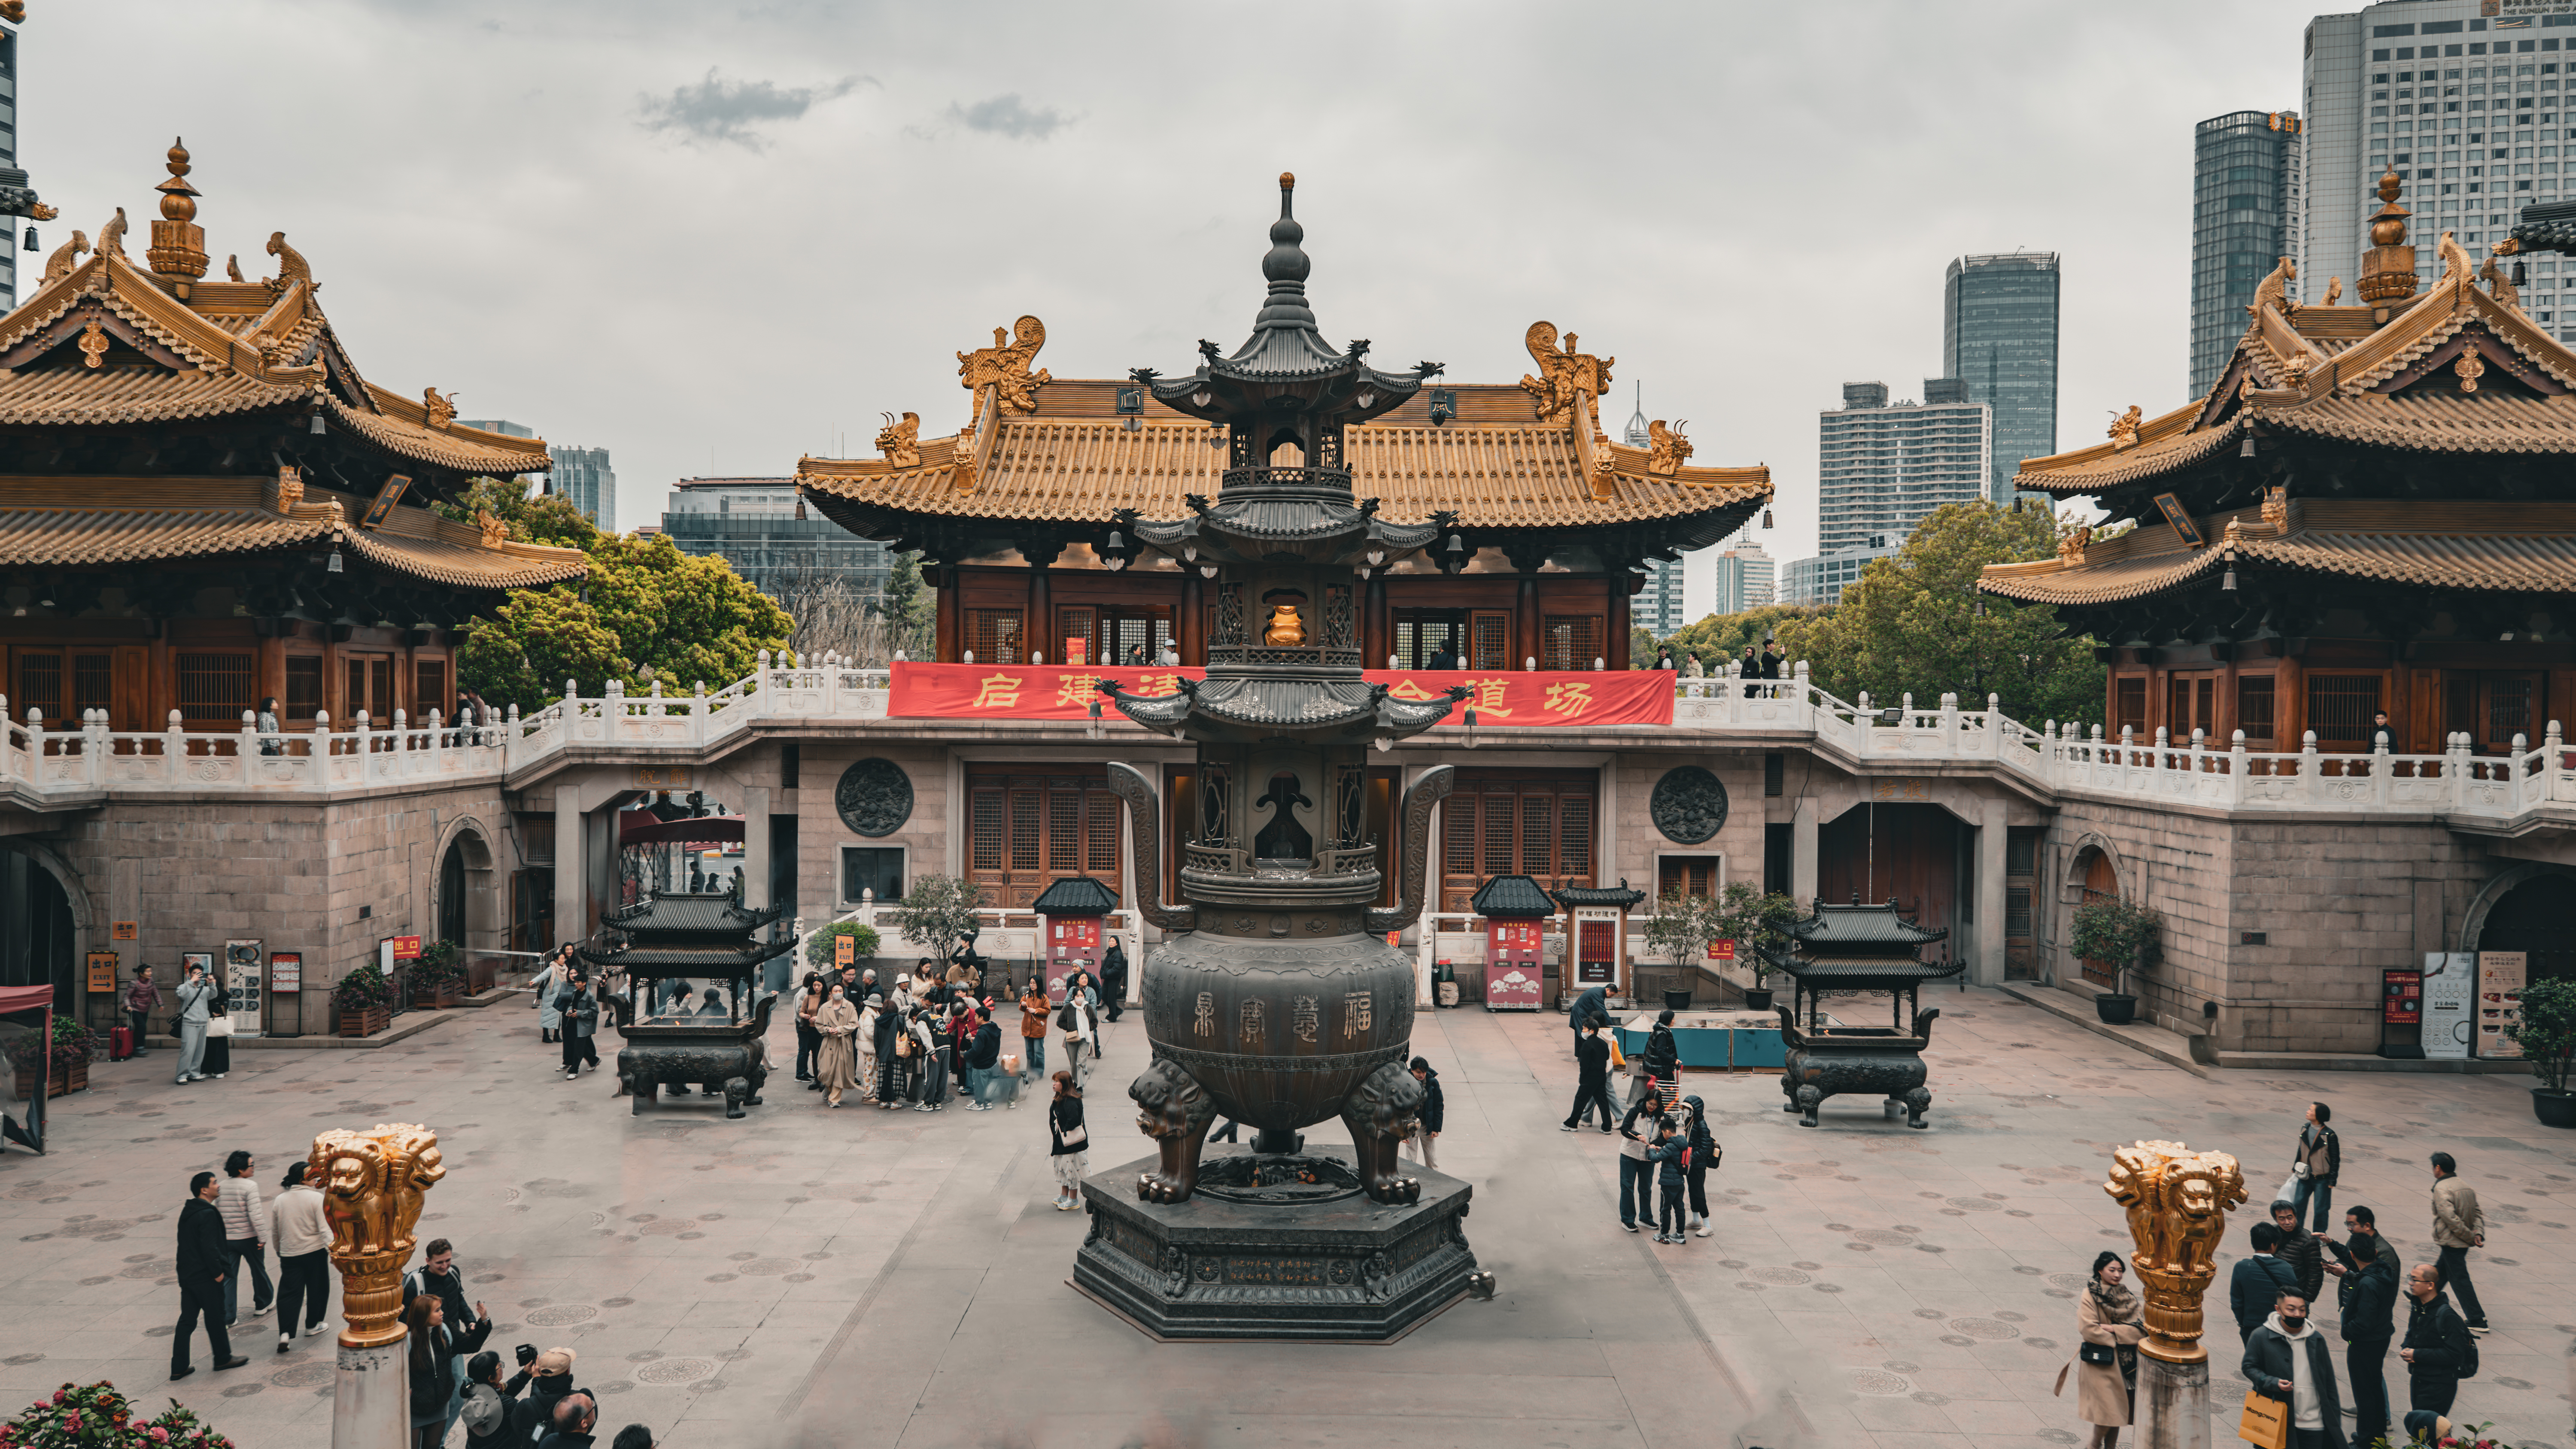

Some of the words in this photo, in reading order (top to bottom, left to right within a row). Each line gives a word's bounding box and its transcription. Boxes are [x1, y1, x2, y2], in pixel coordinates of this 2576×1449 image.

[395, 940, 418, 950] 出口
[838, 940, 852, 950] 出口
[1710, 942, 1731, 951] 出口
[92, 958, 112, 969] 出口
[2245, 1406, 2278, 1423] Mangoway
